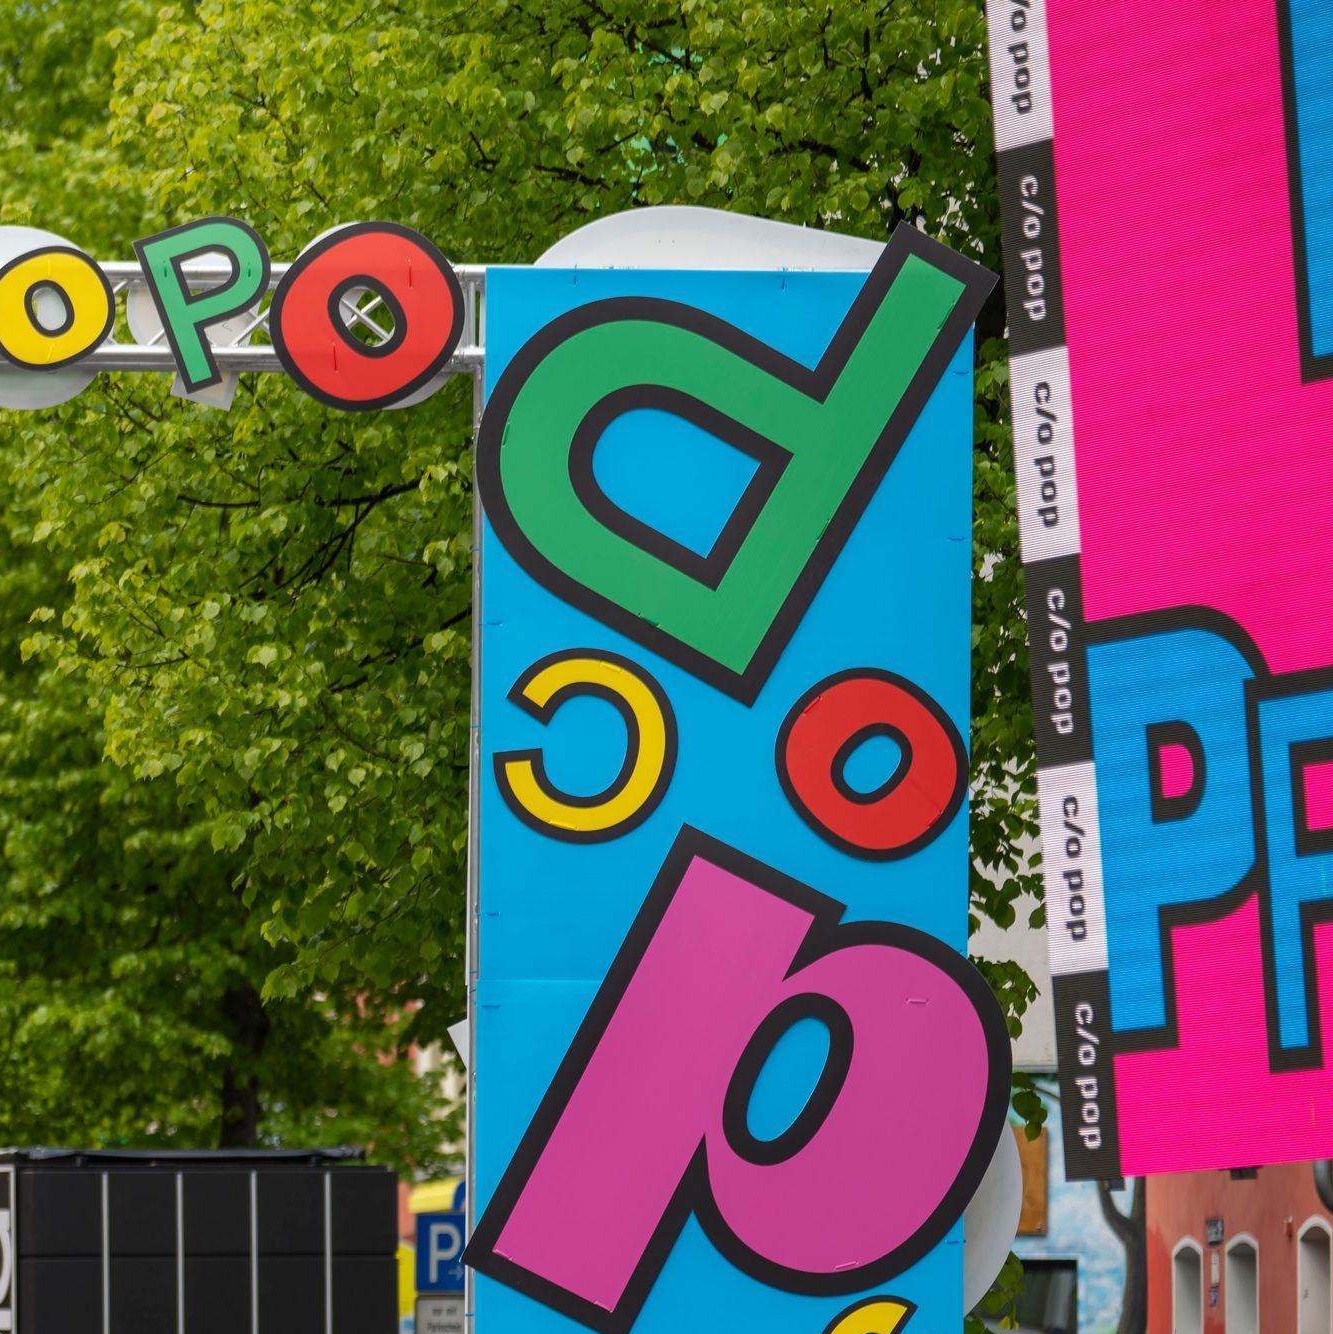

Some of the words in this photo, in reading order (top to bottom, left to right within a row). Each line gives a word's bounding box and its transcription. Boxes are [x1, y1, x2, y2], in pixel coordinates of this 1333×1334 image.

[1007, 42, 1033, 115] pop
[1019, 175, 1041, 238] c/o
[1020, 250, 1047, 322] pop
[1033, 381, 1054, 445] c/o
[1033, 454, 1061, 528] pop
[1046, 587, 1070, 652] c/o
[1047, 662, 1074, 735] pop
[1062, 795, 1084, 857] c/o
[1062, 868, 1087, 943] pop
[1074, 1003, 1098, 1066] c/o
[1076, 1076, 1102, 1151] pop
[429, 1222, 461, 1283] P
